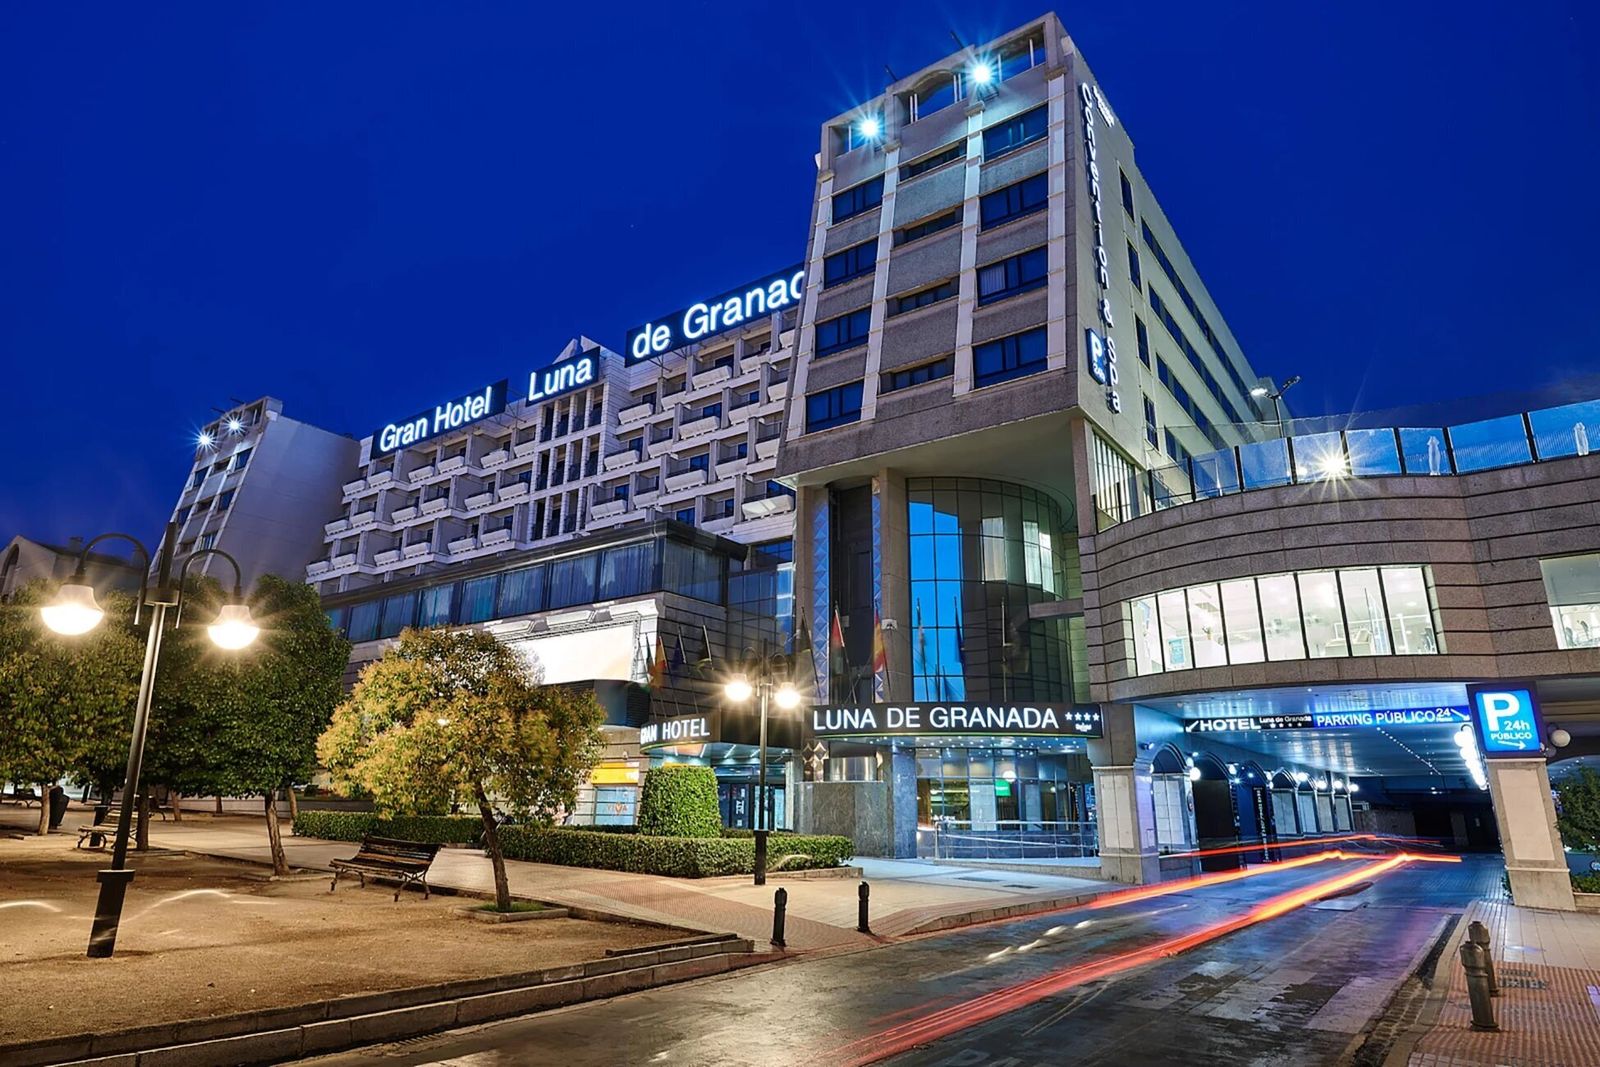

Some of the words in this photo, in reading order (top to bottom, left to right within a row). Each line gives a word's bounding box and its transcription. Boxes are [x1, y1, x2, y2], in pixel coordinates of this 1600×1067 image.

[1081, 82, 1109, 290] Convention
[1103, 298, 1114, 328] &
[632, 322, 670, 358] de
[1090, 331, 1103, 361] P
[528, 358, 593, 402] Luna
[380, 424, 428, 452] Gran
[433, 386, 492, 434] Hotel
[813, 708, 877, 731] LUNA
[887, 707, 921, 729] DE
[929, 706, 1060, 729] GRANADA
[1200, 718, 1262, 731] HOTEL
[1316, 713, 1373, 726] PARKING
[1375, 710, 1436, 724] PÚBLICO
[1436, 707, 1450, 717] 24
[1482, 692, 1520, 732] P
[1503, 720, 1531, 731] 24h
[662, 717, 711, 740] HOTEL
[1490, 731, 1533, 741] PÚBLICO
